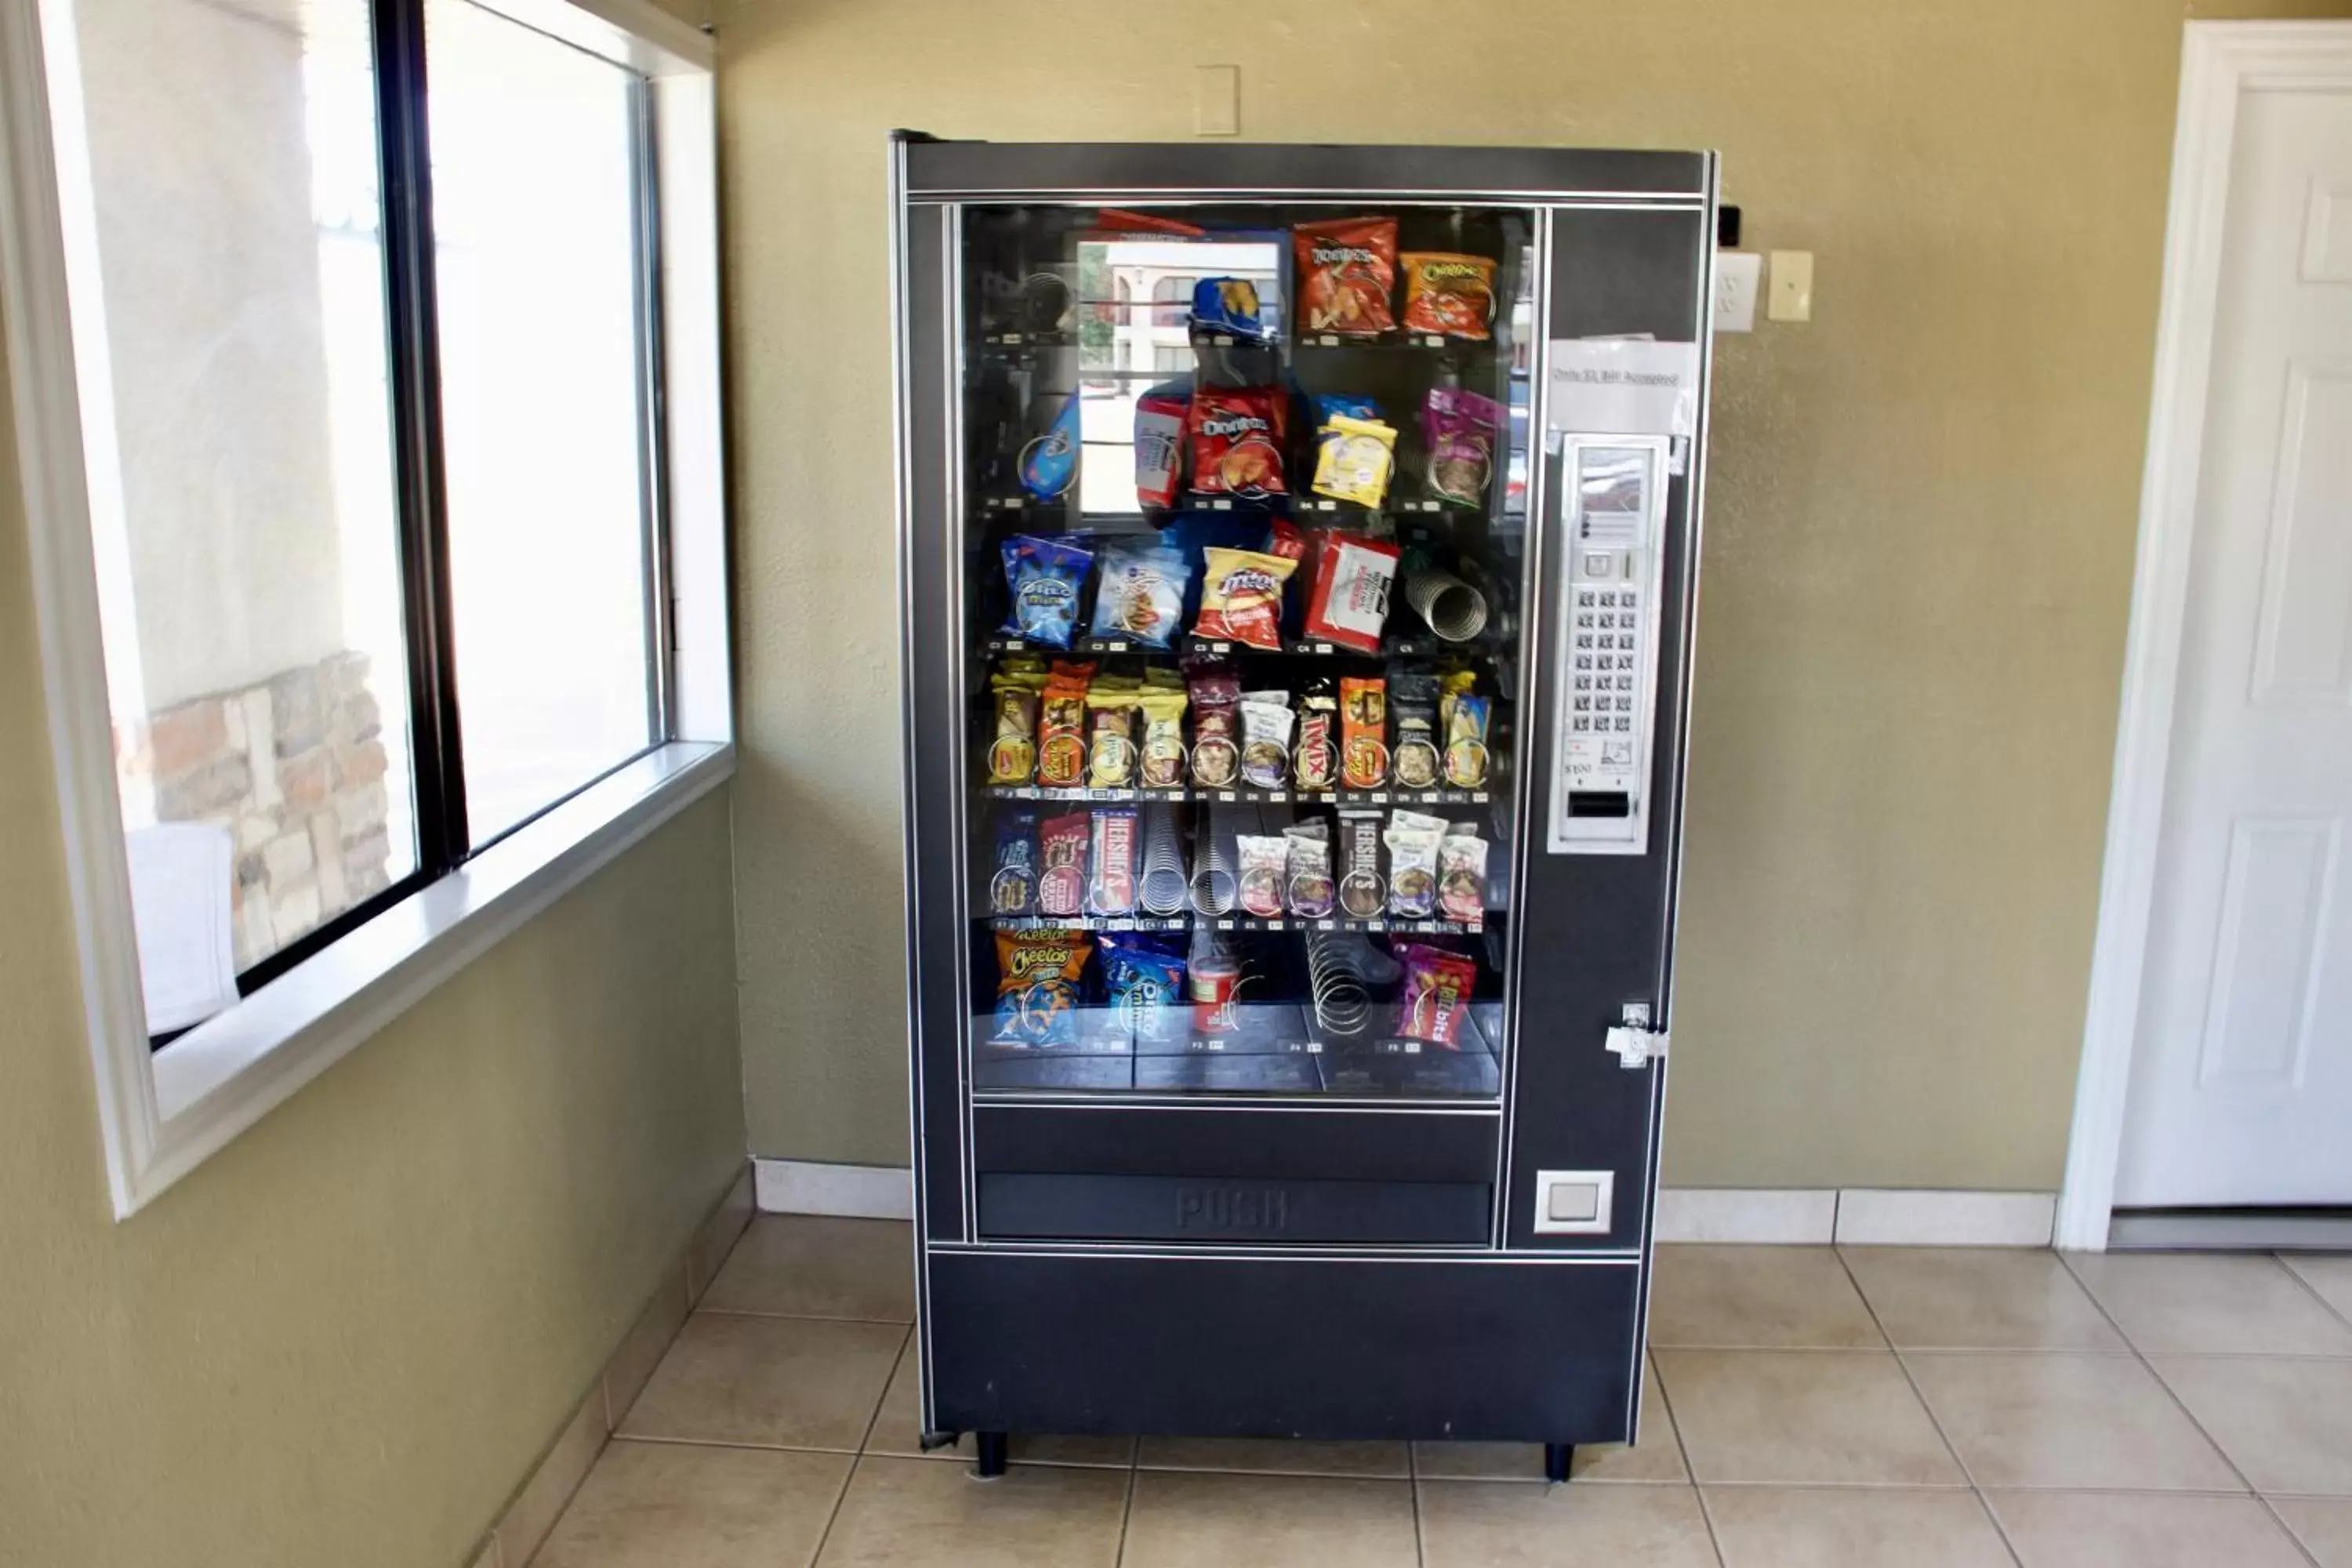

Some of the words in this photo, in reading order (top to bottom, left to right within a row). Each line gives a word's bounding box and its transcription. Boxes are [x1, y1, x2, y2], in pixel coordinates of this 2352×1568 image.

[1304, 713, 1330, 776] TWIX
[1107, 818, 1131, 887] HERSHEY'S
[1355, 821, 1377, 890] HERSHEY'S
[1012, 947, 1069, 975] Cheetos
